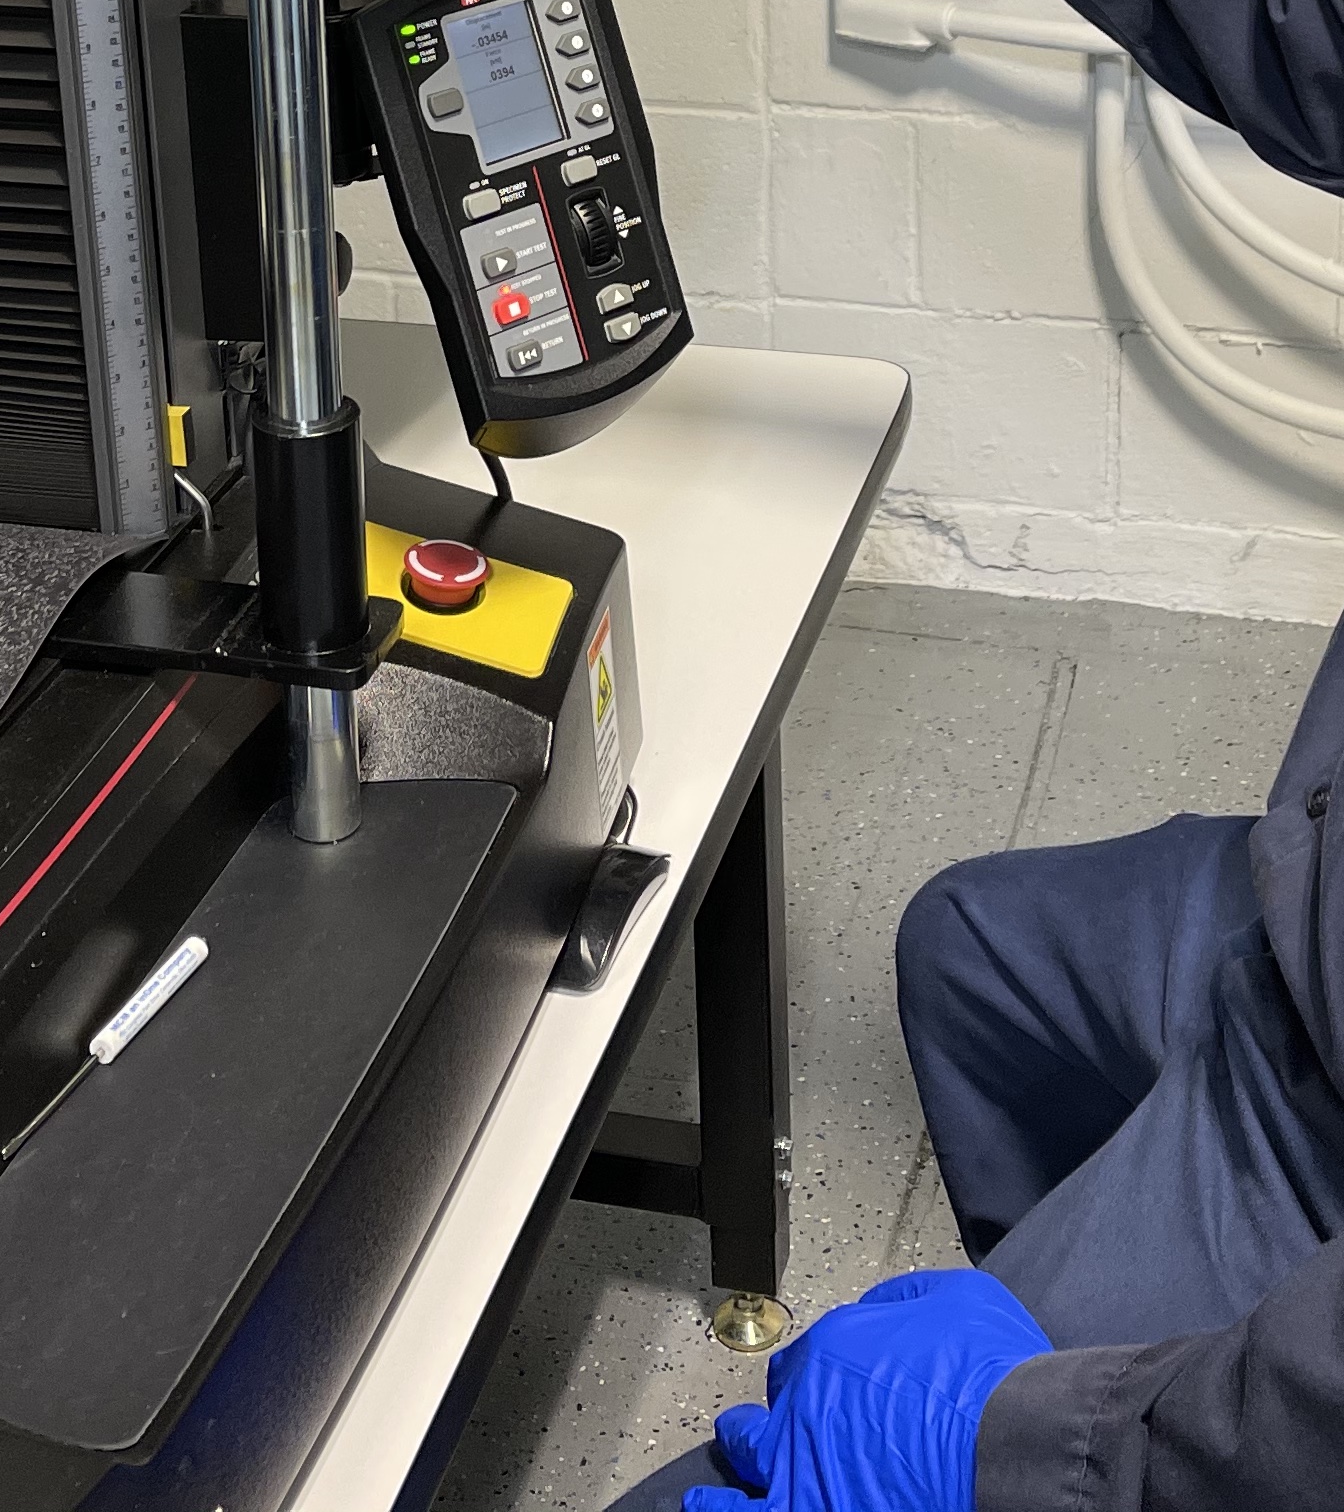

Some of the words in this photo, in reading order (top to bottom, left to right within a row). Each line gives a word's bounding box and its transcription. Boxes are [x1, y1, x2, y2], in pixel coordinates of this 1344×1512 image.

[416, 19, 437, 30] POWER
[472, 30, 509, 48] -.03454
[596, 155, 612, 166] RESET
[499, 181, 528, 197] SPECIMEN
[501, 189, 526, 204] PROTECT
[613, 213, 626, 223] FINE
[616, 215, 642, 231] POSITION
[516, 246, 533, 259] START
[534, 241, 547, 253] TEST
[631, 282, 642, 293] JOG
[642, 279, 650, 288] UP
[529, 293, 544, 304] STOP
[544, 287, 558, 299] TEST
[640, 314, 650, 325] JOG
[650, 307, 668, 320] DOWN
[541, 335, 564, 350] RETURN
